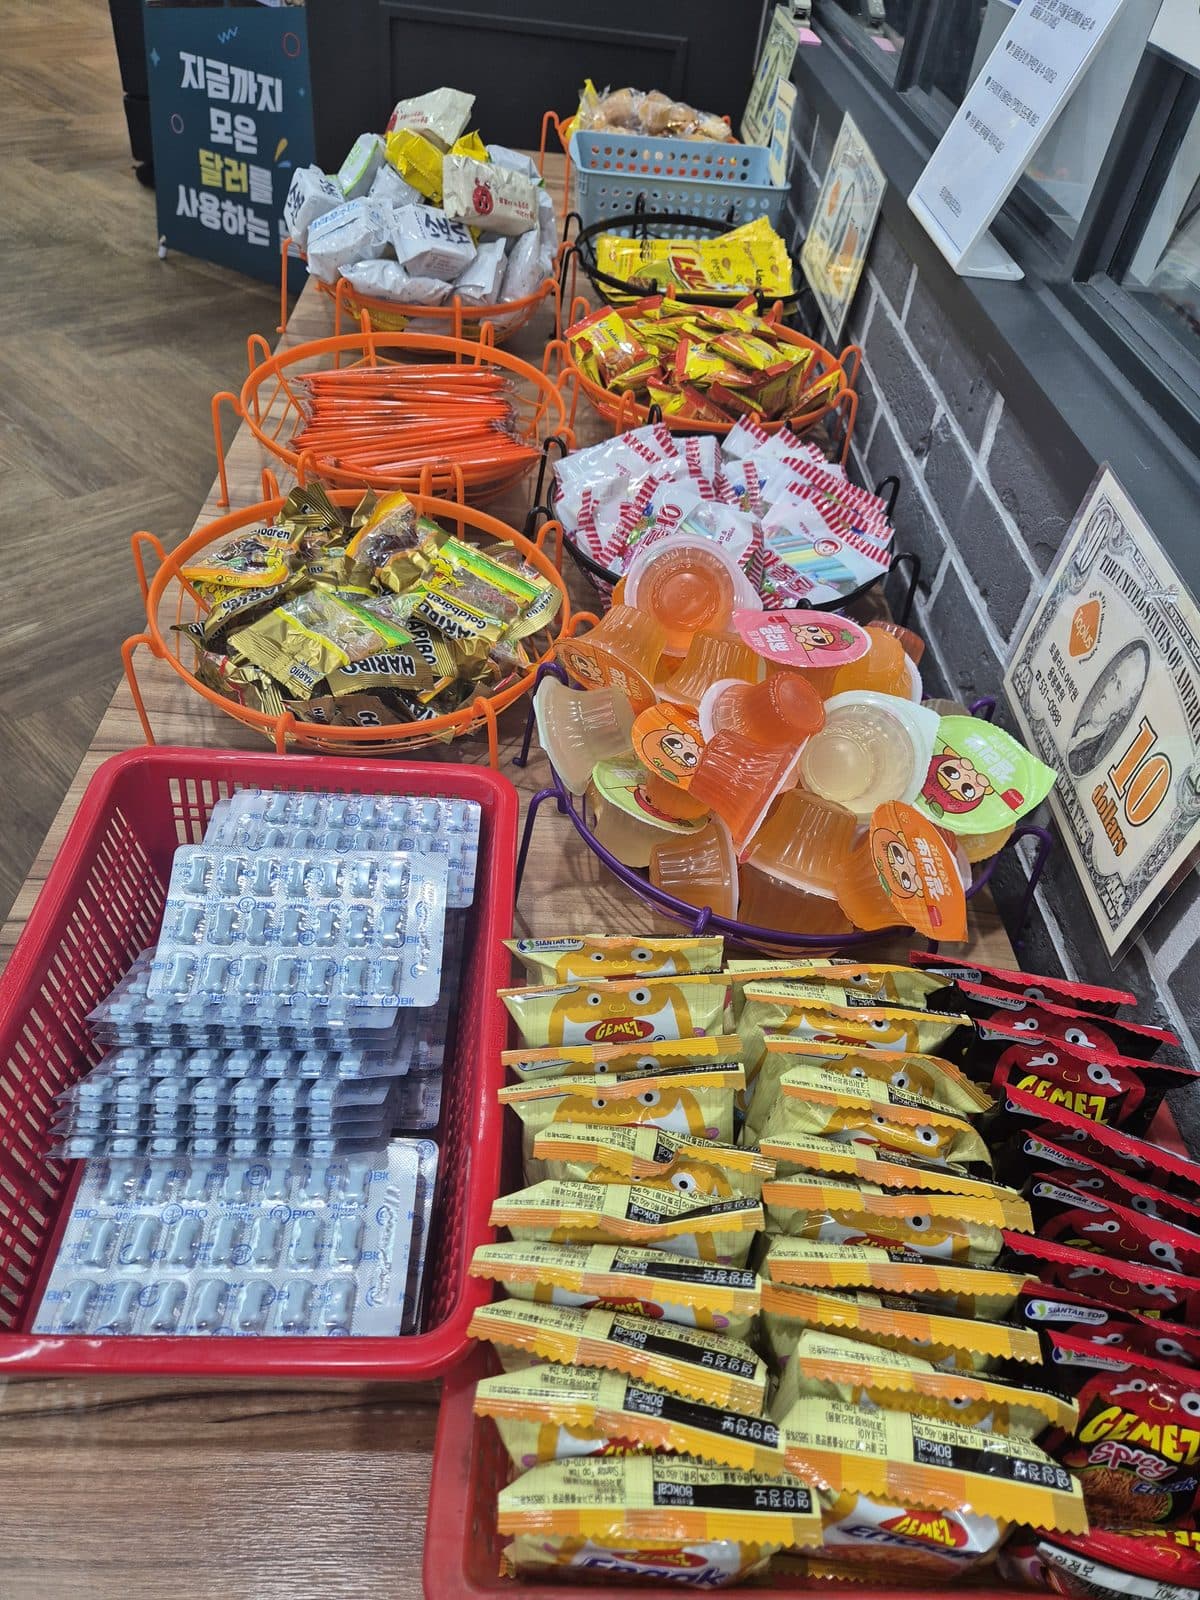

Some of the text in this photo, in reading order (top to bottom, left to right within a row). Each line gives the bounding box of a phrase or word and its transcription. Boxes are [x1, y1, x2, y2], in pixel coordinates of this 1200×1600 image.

[178, 51, 283, 113] 지금까지
[209, 107, 258, 154] 모은
[198, 148, 273, 206] 달러를
[176, 184, 271, 247] 사용하는
[426, 592, 487, 629] Goldbären
[527, 592, 554, 619] HARIBO
[1099, 554, 1120, 582] THE
[1140, 602, 1174, 655] STATES
[1166, 645, 1184, 673] OF
[1062, 673, 1080, 703] 어학원
[1108, 716, 1172, 827] 10
[1091, 781, 1128, 857] dollars
[911, 836, 946, 901] 젤리뽀
[535, 939, 565, 948] SIANTAR
[594, 1019, 644, 1041] GEMEZ
[1016, 1073, 1109, 1126] GEMEZ
[630, 1204, 662, 1223] 80kcal
[1048, 1306, 1084, 1317] SIANTAR
[613, 1326, 648, 1344] 80kcal
[701, 1350, 754, 1378] 영양정보
[628, 1389, 665, 1408] 80kcal
[721, 1416, 779, 1445] 영양정보
[1079, 1406, 1200, 1466] GEMEZ
[914, 1439, 952, 1459] 80kcal
[1088, 1441, 1178, 1481] Spicy
[1012, 1459, 1071, 1489] 영양정보
[656, 1482, 694, 1497] 80kcal
[754, 1489, 809, 1510] 영양정보
[892, 1516, 957, 1548] GEMEZ
